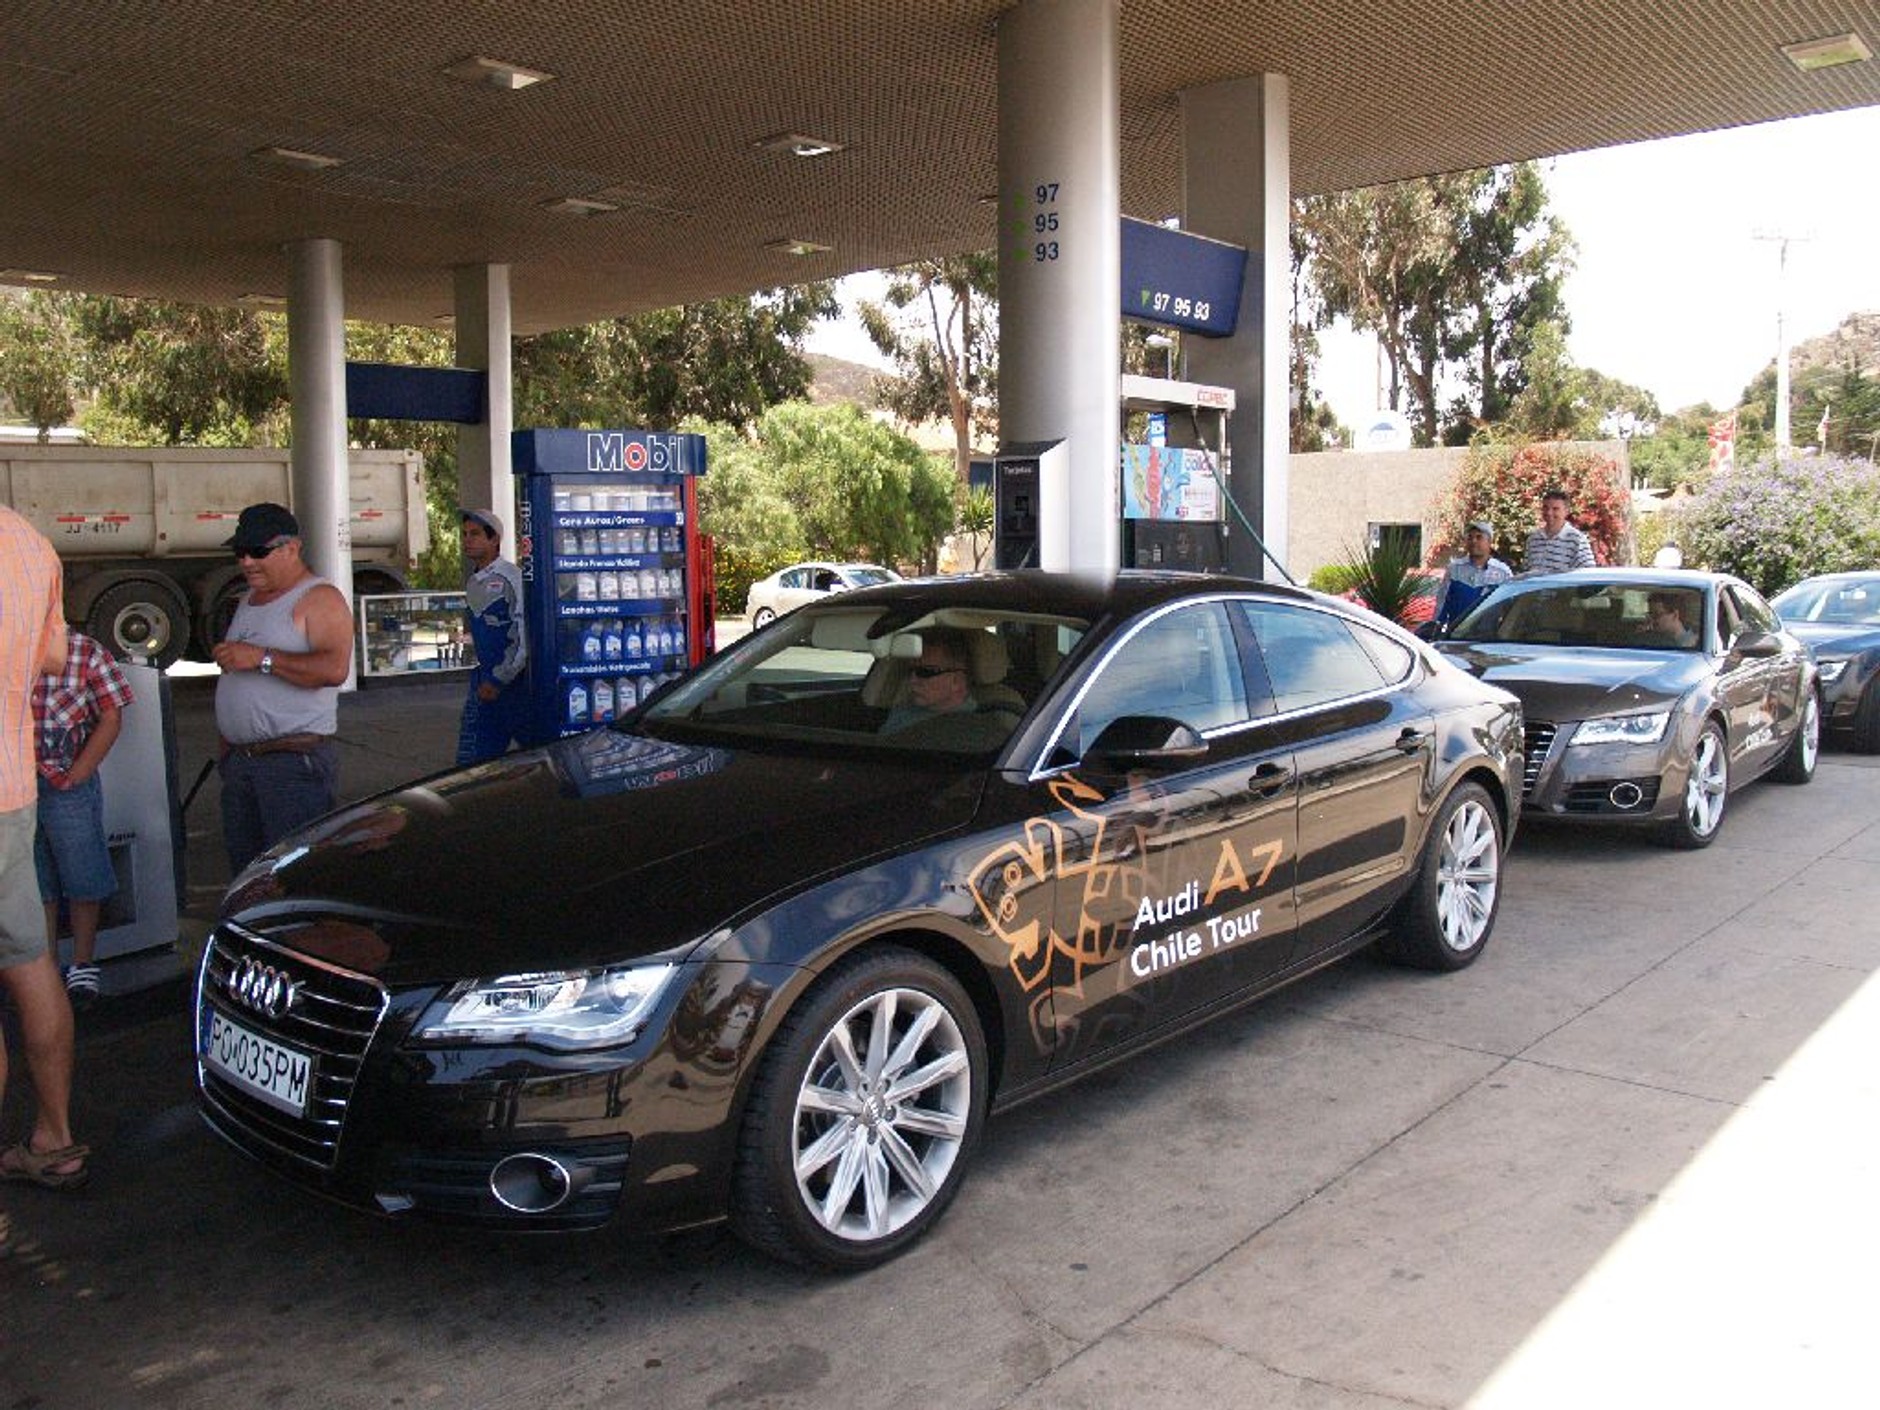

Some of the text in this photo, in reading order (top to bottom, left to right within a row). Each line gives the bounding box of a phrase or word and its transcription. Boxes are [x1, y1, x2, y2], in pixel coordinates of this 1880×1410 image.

[1036, 184, 1059, 204] 97
[1035, 213, 1059, 233] 95
[1035, 242, 1059, 262] 93
[1153, 292, 1210, 321] 97 95 93
[587, 433, 685, 473] Mobil
[1132, 838, 1283, 932] Audi A7
[1130, 908, 1262, 977] Chile Tour
